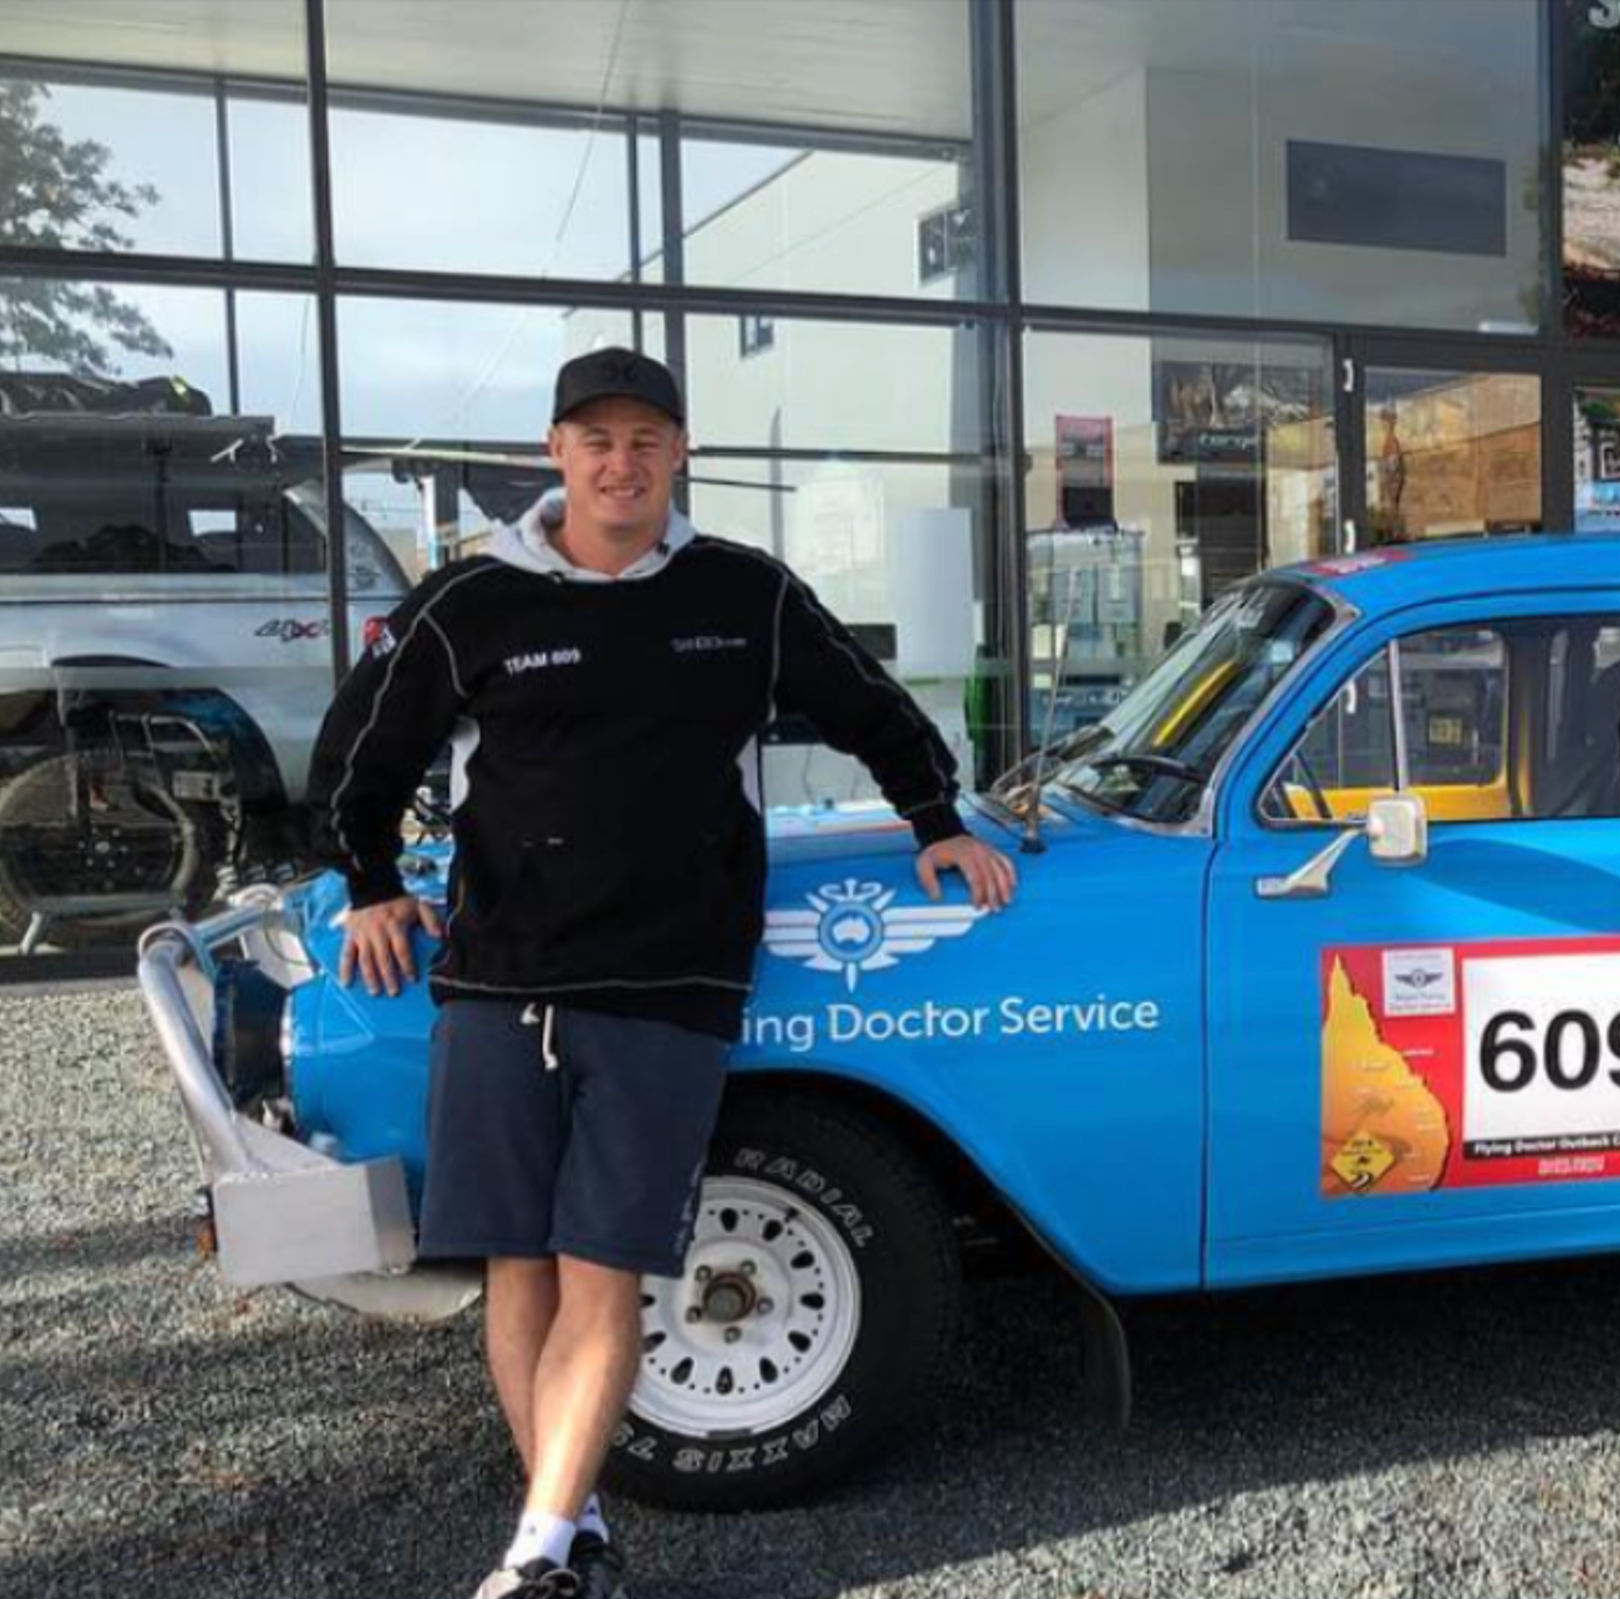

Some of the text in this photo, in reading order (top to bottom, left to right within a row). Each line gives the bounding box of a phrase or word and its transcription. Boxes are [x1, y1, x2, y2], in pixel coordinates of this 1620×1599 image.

[504, 651, 548, 675] TEAM
[740, 995, 1160, 1052] ing Doctor Service
[734, 1148, 875, 1247] RADIAL
[673, 1395, 852, 1474] MAXXIS
